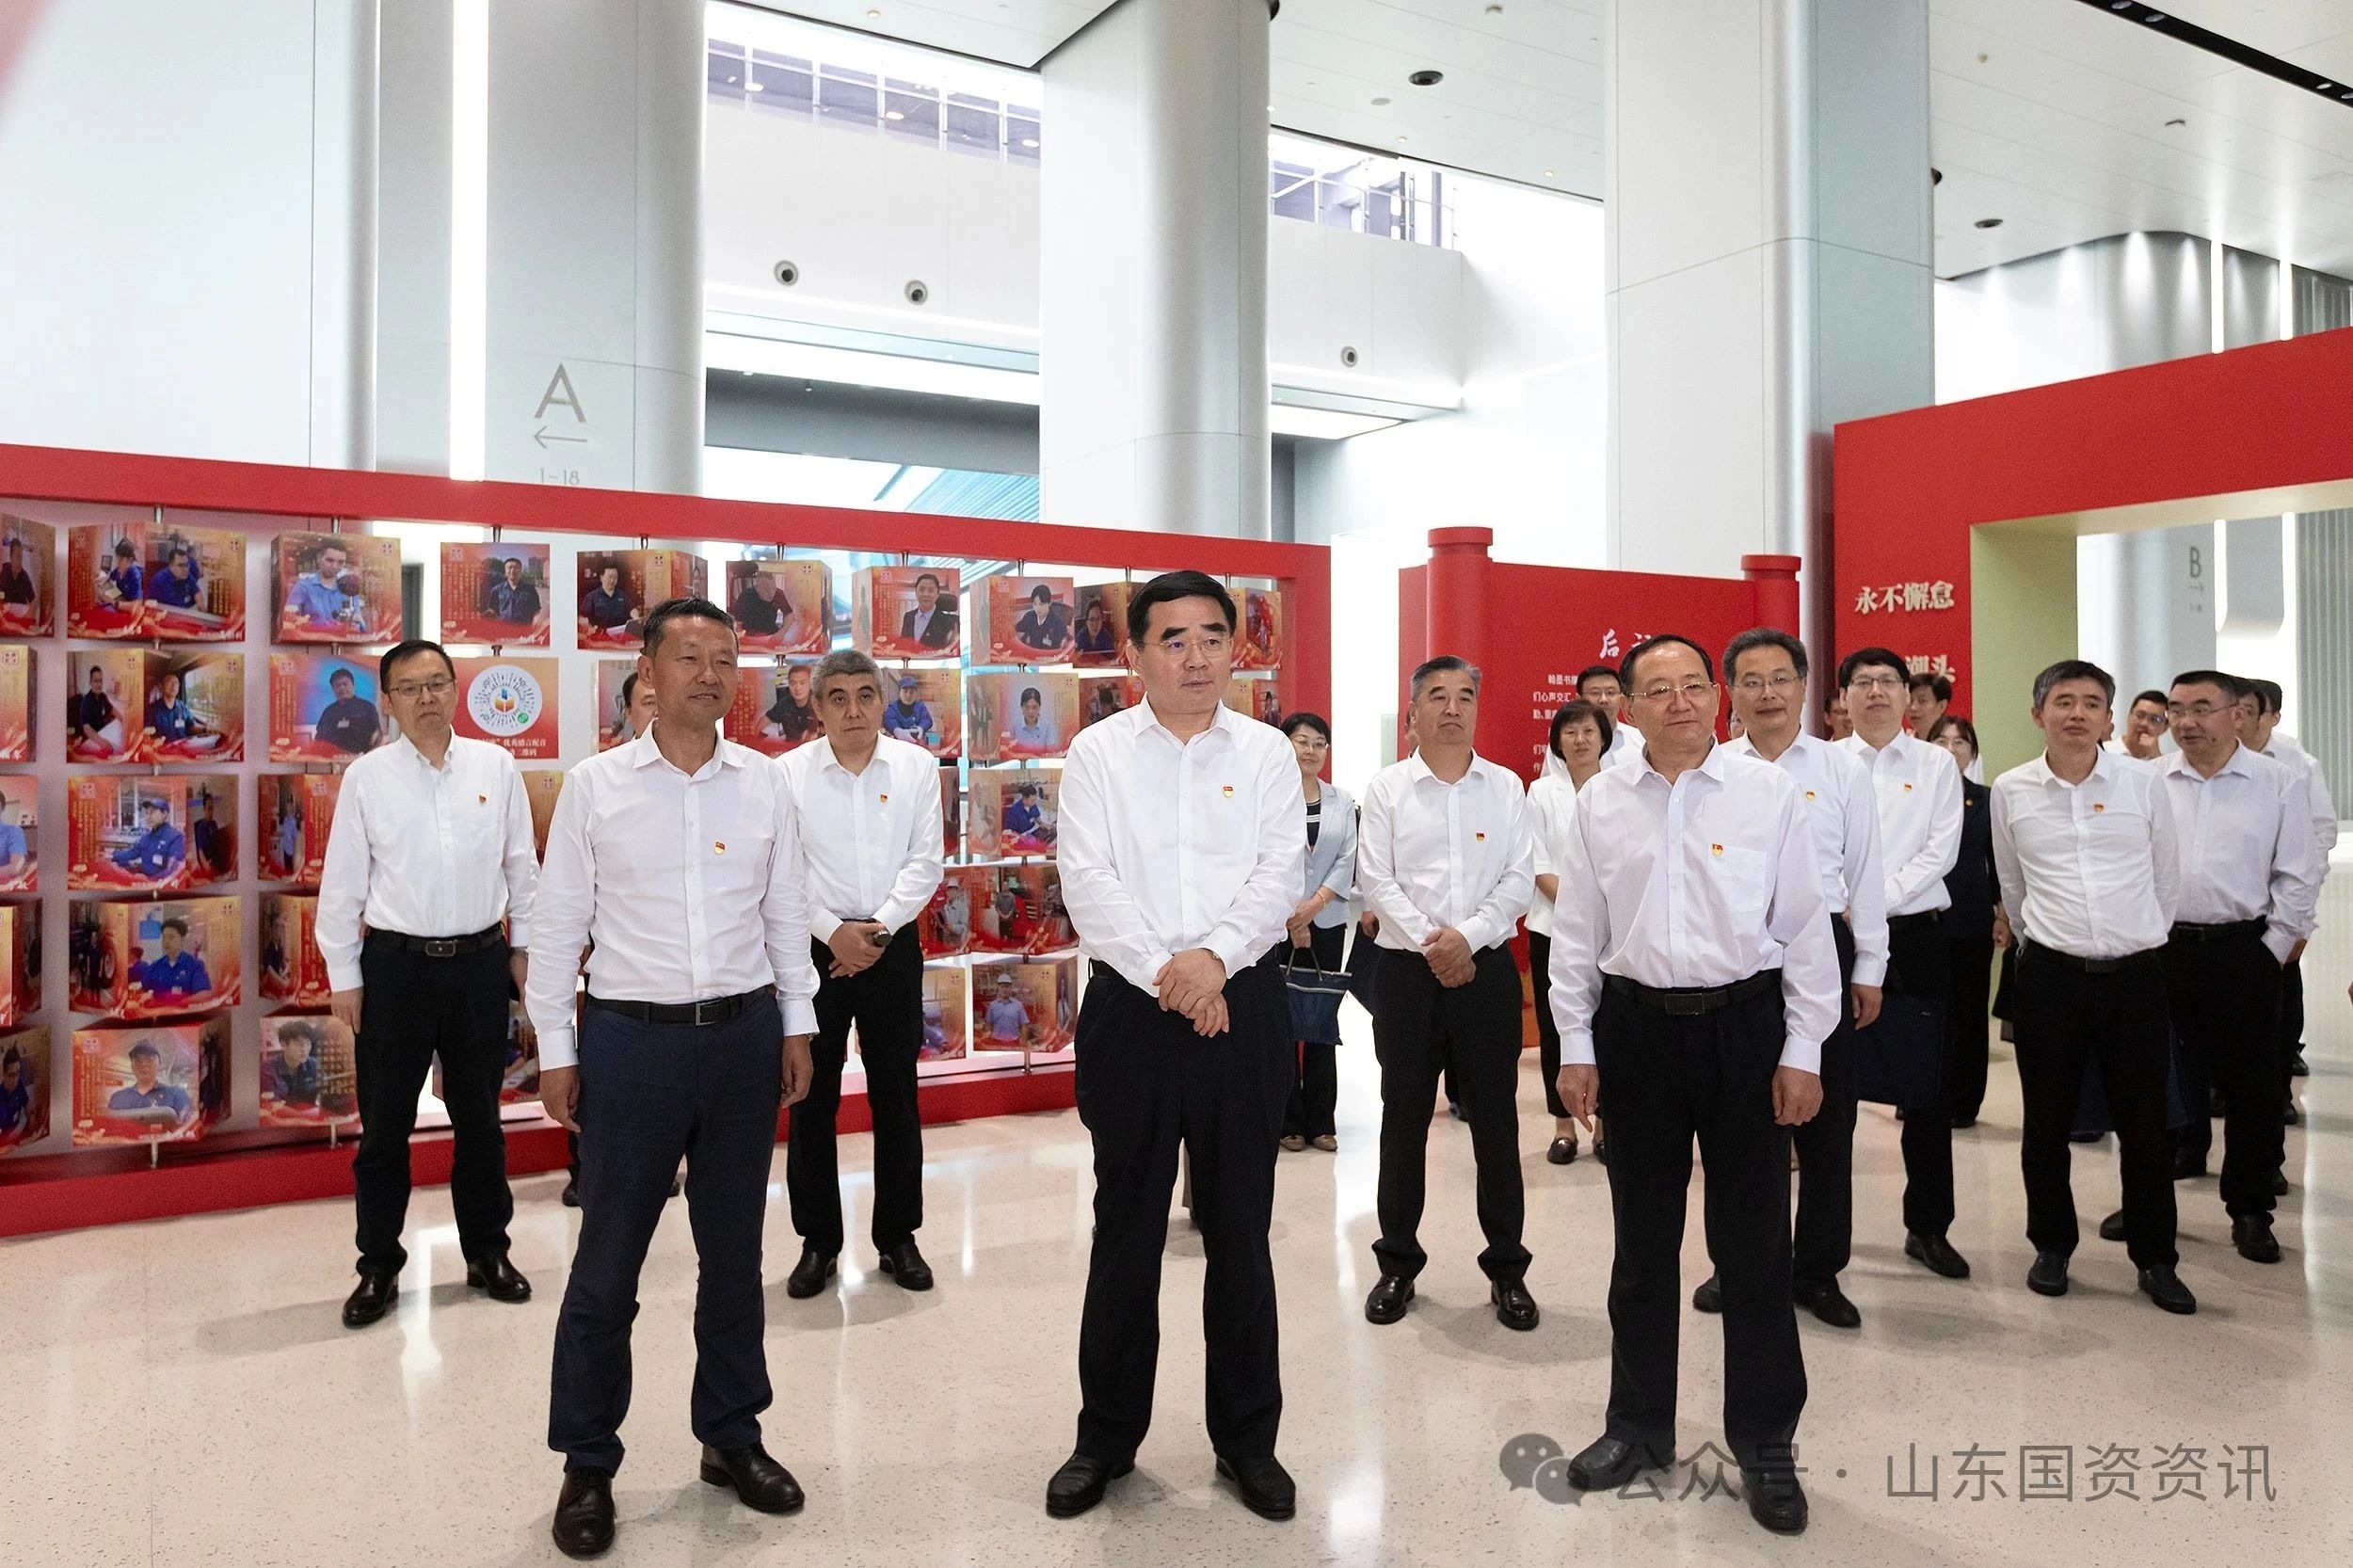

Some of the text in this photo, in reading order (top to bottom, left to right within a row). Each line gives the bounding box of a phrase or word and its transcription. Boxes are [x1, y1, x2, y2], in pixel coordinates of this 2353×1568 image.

[534, 363, 587, 423] A
[2189, 547, 2201, 577] B
[1854, 580, 1955, 615] 永不懈怠
